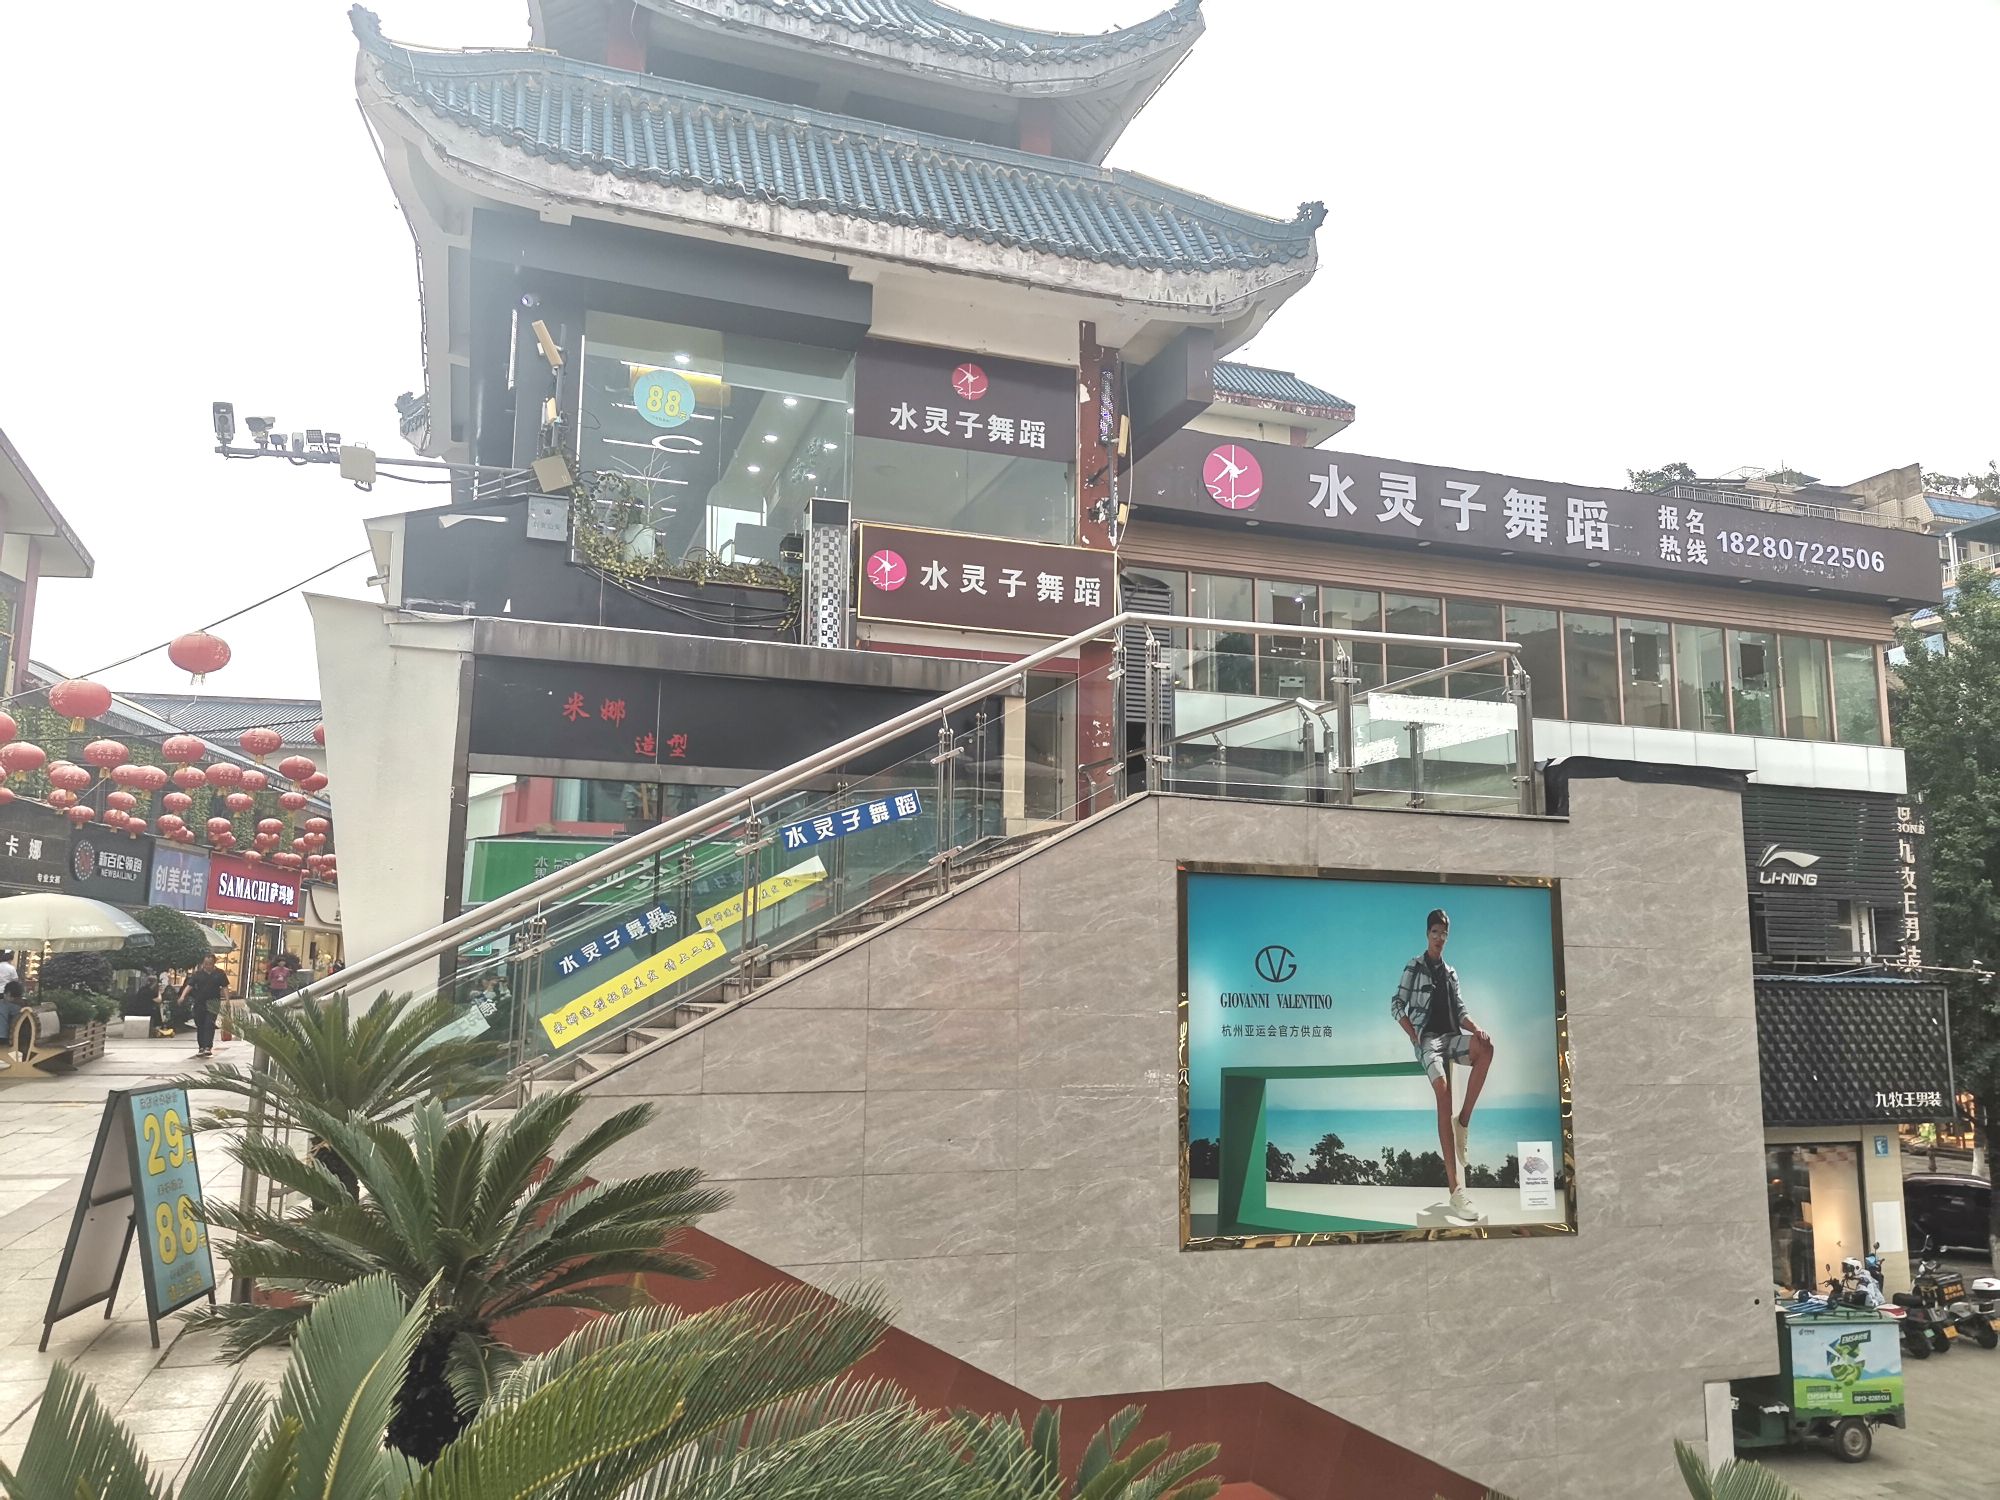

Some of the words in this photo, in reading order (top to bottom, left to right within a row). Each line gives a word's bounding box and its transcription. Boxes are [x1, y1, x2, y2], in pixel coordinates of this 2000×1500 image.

[889, 401, 1047, 450] 水灵子舞蹈
[1308, 462, 1612, 552] 水灵子舞蹈
[1657, 504, 1705, 535] 报名
[1659, 535, 1709, 566] 热线
[1716, 529, 1886, 573] 18280722506
[919, 560, 1102, 606] 水灵子舞蹈
[562, 691, 626, 728] 米娜
[634, 731, 688, 758] 造型
[785, 792, 918, 850] 水灵子舞蹈
[98, 851, 143, 873] 新百伦领跑
[155, 864, 203, 897] 创美生活
[218, 872, 270, 903] SAMACHI
[1760, 871, 1817, 886] LI-NING
[1220, 992, 1270, 1009] GIOVANNI
[1276, 993, 1333, 1010] VALENTINO
[1221, 1024, 1333, 1038] 杭州亚运会官方供应商
[1875, 1091, 1942, 1108] 九牧王男装
